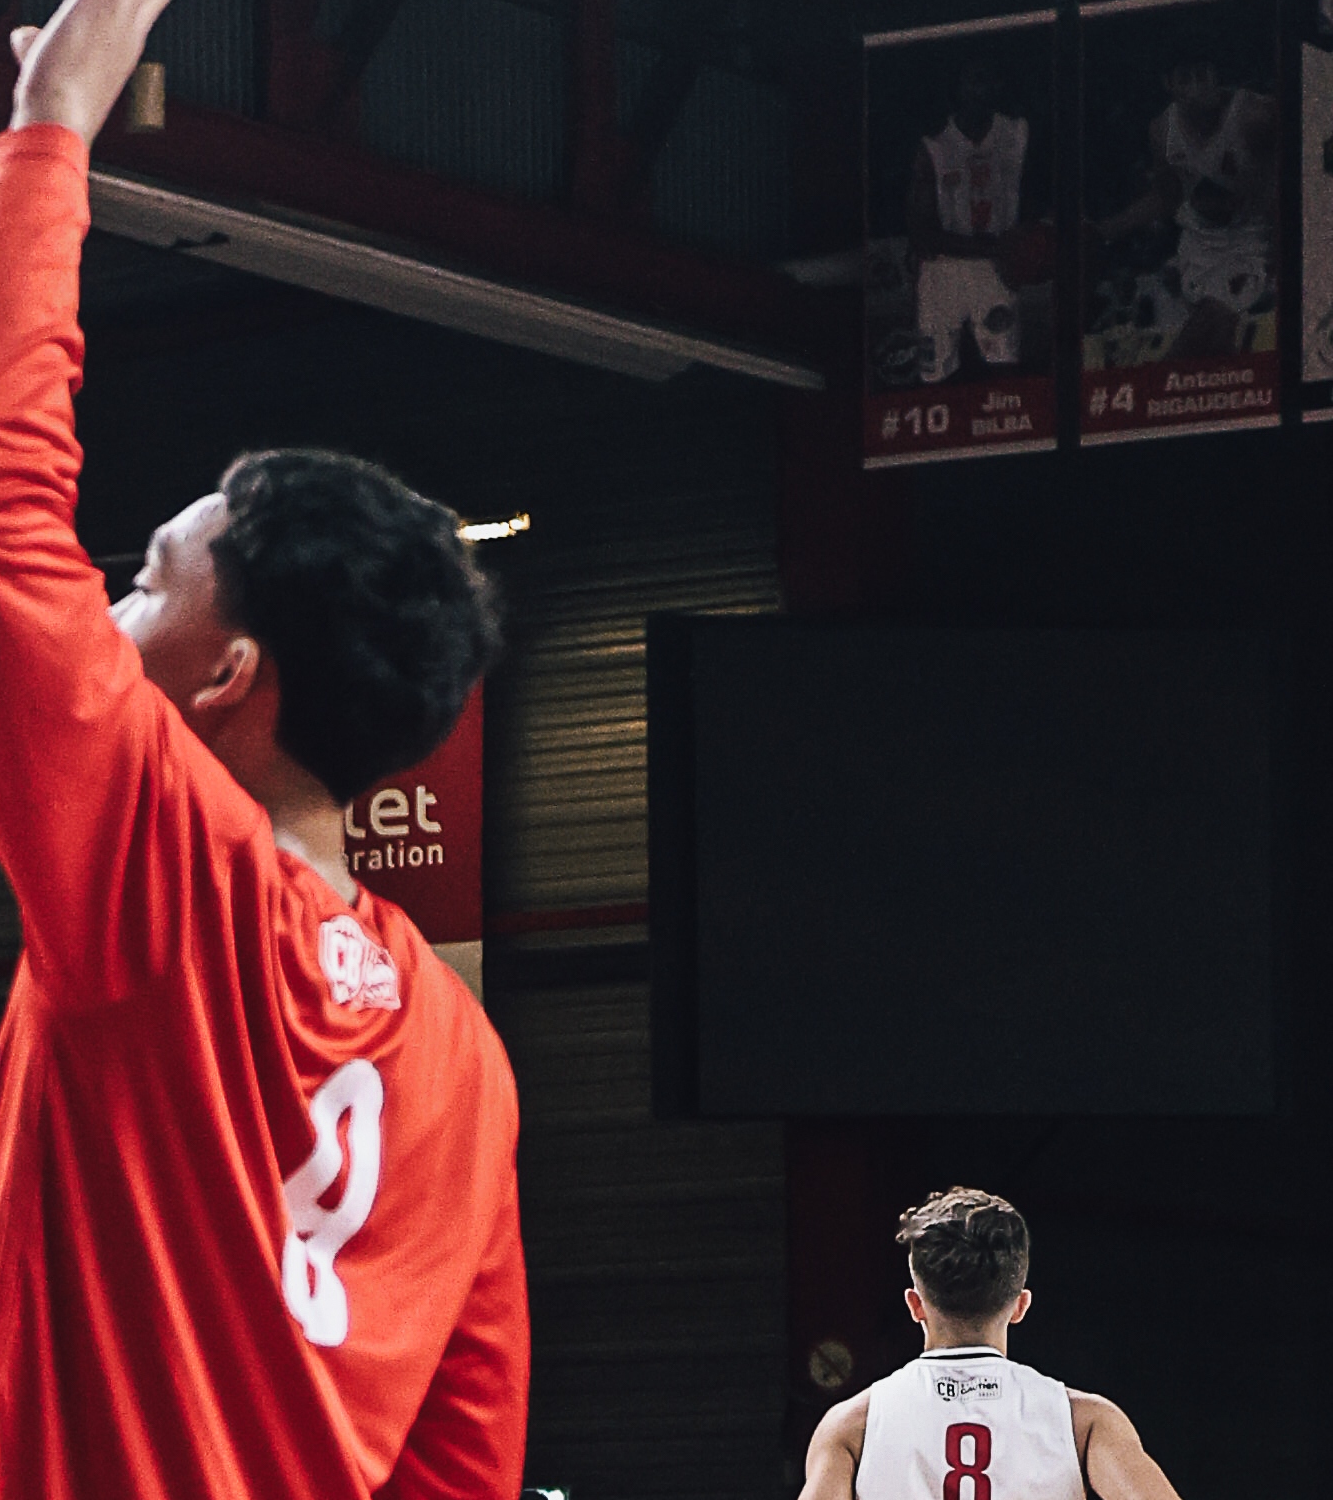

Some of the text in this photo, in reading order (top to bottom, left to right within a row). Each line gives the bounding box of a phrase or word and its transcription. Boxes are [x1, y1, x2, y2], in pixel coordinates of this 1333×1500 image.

[882, 403, 950, 440] #10
[344, 785, 442, 838] let
[354, 841, 443, 871] ration
